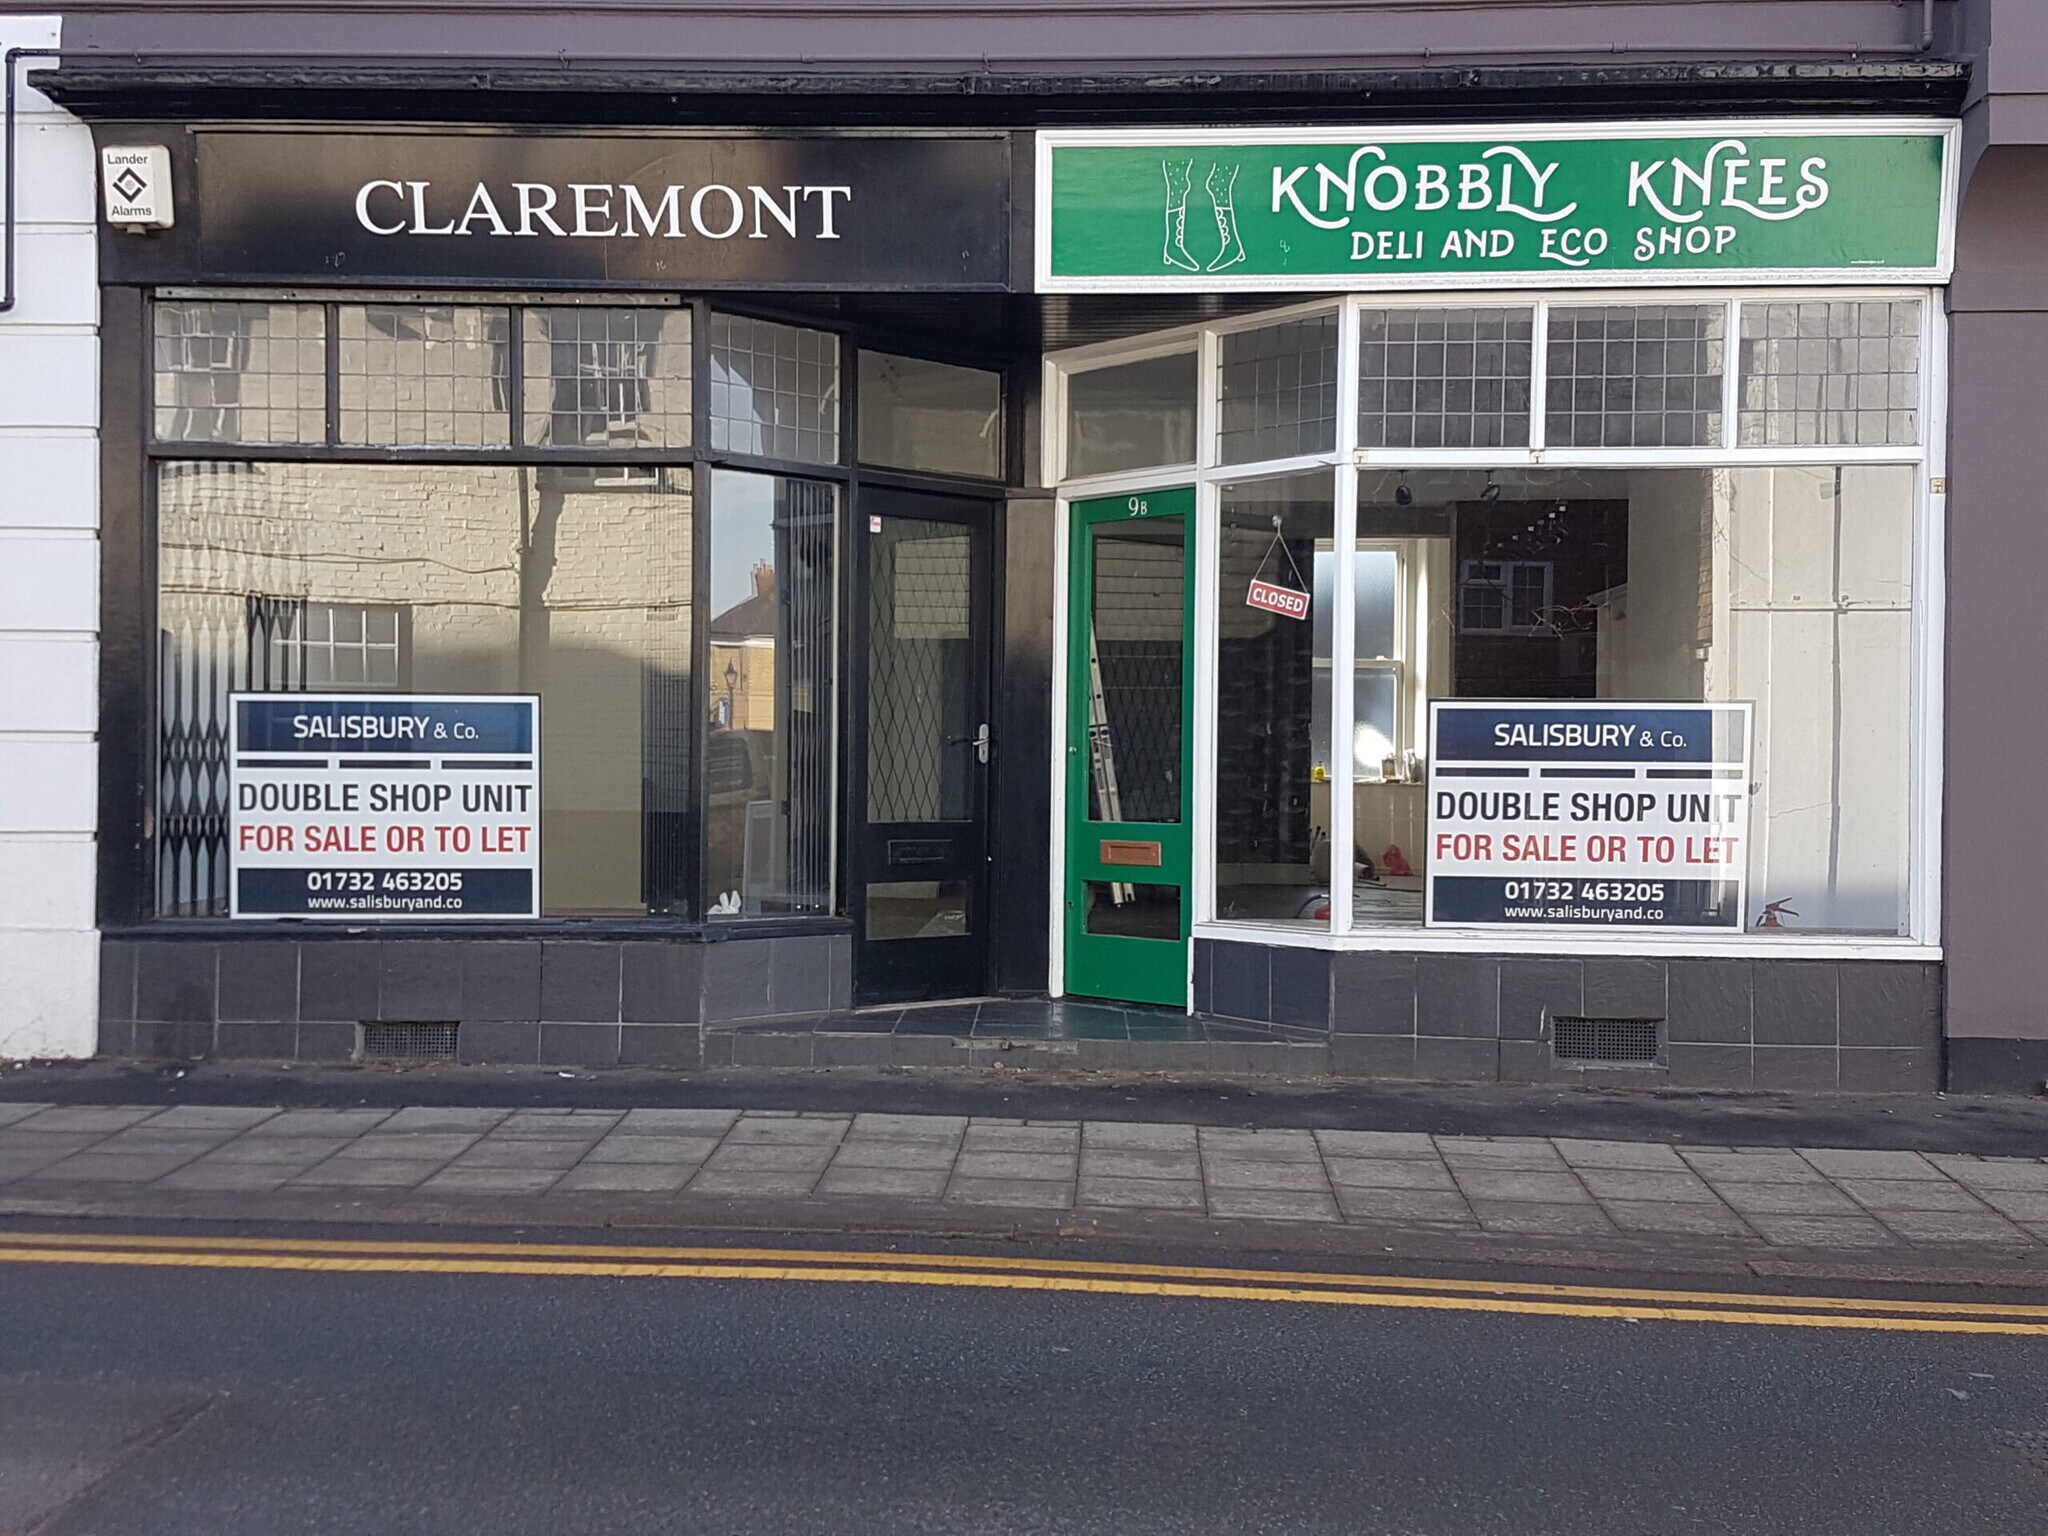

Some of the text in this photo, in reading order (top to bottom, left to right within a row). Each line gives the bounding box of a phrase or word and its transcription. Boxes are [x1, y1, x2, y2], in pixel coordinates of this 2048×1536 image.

[107, 153, 148, 165] Lander
[1271, 139, 1829, 230] KNOBBLY KNEES
[111, 205, 152, 216] Alarms
[355, 180, 852, 240] CLAREMONT
[1350, 225, 1737, 267] DELI AND ECO SHOP
[1128, 496, 1148, 517] 9B
[1252, 587, 1304, 613] CLOSED
[293, 715, 479, 740] SALISBURY & Co.
[1494, 723, 1687, 748] SALISBURY & Co.
[238, 783, 533, 813] DOUBLE SHOP UNIT
[1436, 791, 1742, 823] DOUBLE SHOP UNIT
[239, 825, 532, 853] FOR SALE OR TO LET
[1436, 833, 1739, 864] FOR SALE OR TO LET
[307, 872, 463, 891] 01732 463205
[1504, 881, 1665, 902] 01732 463205
[307, 895, 463, 912] www.salisburyand.co
[1504, 905, 1665, 923] www.salisburyand.co
